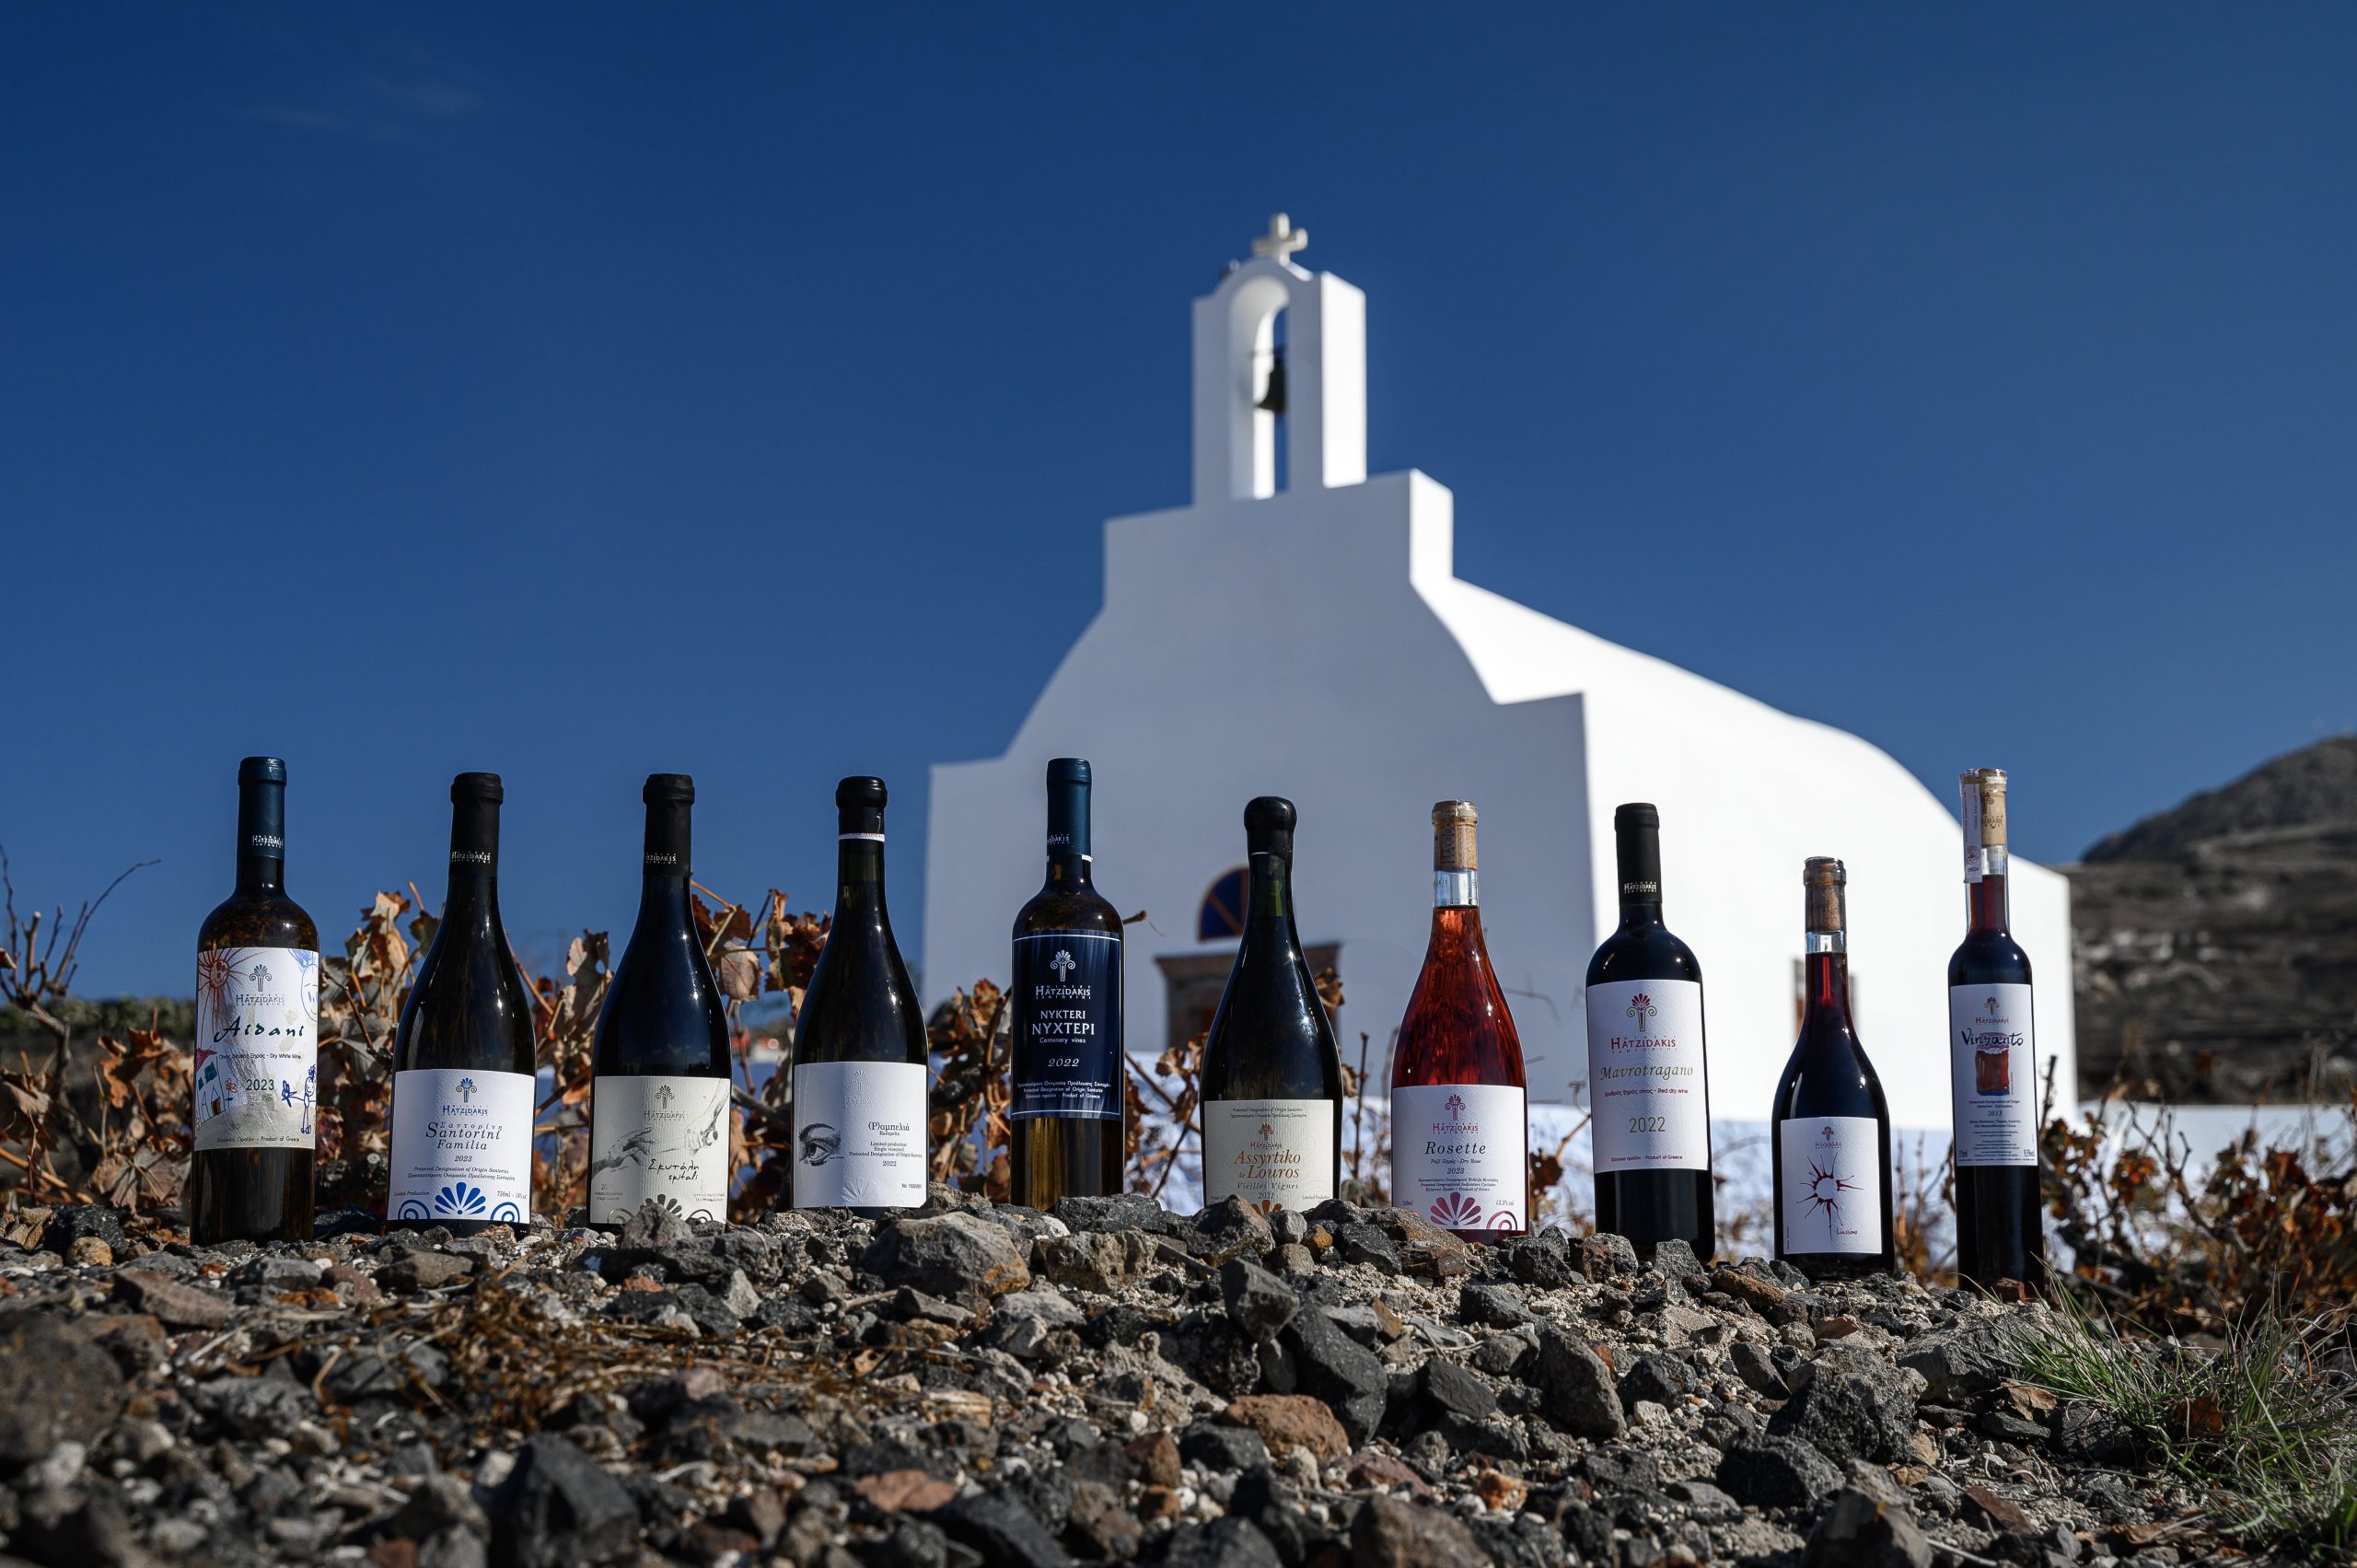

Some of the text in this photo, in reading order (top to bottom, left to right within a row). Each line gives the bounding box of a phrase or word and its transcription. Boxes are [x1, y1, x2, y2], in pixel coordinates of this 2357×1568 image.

[451, 852, 490, 861] HATZIDAKIS
[1036, 986, 1091, 996] HATZIDAKIS
[236, 994, 285, 1004] HATZIDAKIS
[1040, 1010, 1086, 1019] NYKTERI
[213, 1016, 305, 1043] Aidani
[1031, 1022, 1096, 1036] ΝΥΧΤΕΡΙ
[1960, 1027, 2024, 1047] Vinsanto
[1610, 1037, 1677, 1050] HATZIDAKIS
[1048, 1058, 1080, 1067] 2022
[1599, 1064, 1694, 1081] Mavrotragano
[246, 1078, 275, 1091] 2023
[443, 1105, 489, 1114] HATZIDAKIS
[425, 1121, 501, 1140] Santorini
[440, 1121, 503, 1132] Σαντορίνη
[1433, 1122, 1479, 1132] HATZIDAKIS
[1629, 1116, 1666, 1133] 2022
[436, 1139, 488, 1150] Familia
[1424, 1141, 1486, 1155] Rosette
[453, 1155, 473, 1163] 2023
[1233, 1149, 1301, 1169] Assyrtiko
[465, 1166, 471, 1174] of
[648, 1158, 700, 1175] Σκυτάλη
[1247, 1164, 1300, 1179] Louros
[1446, 1167, 1466, 1175] 2023
[668, 1170, 698, 1185] skitali
[1237, 1181, 1268, 1190] Vieilles
